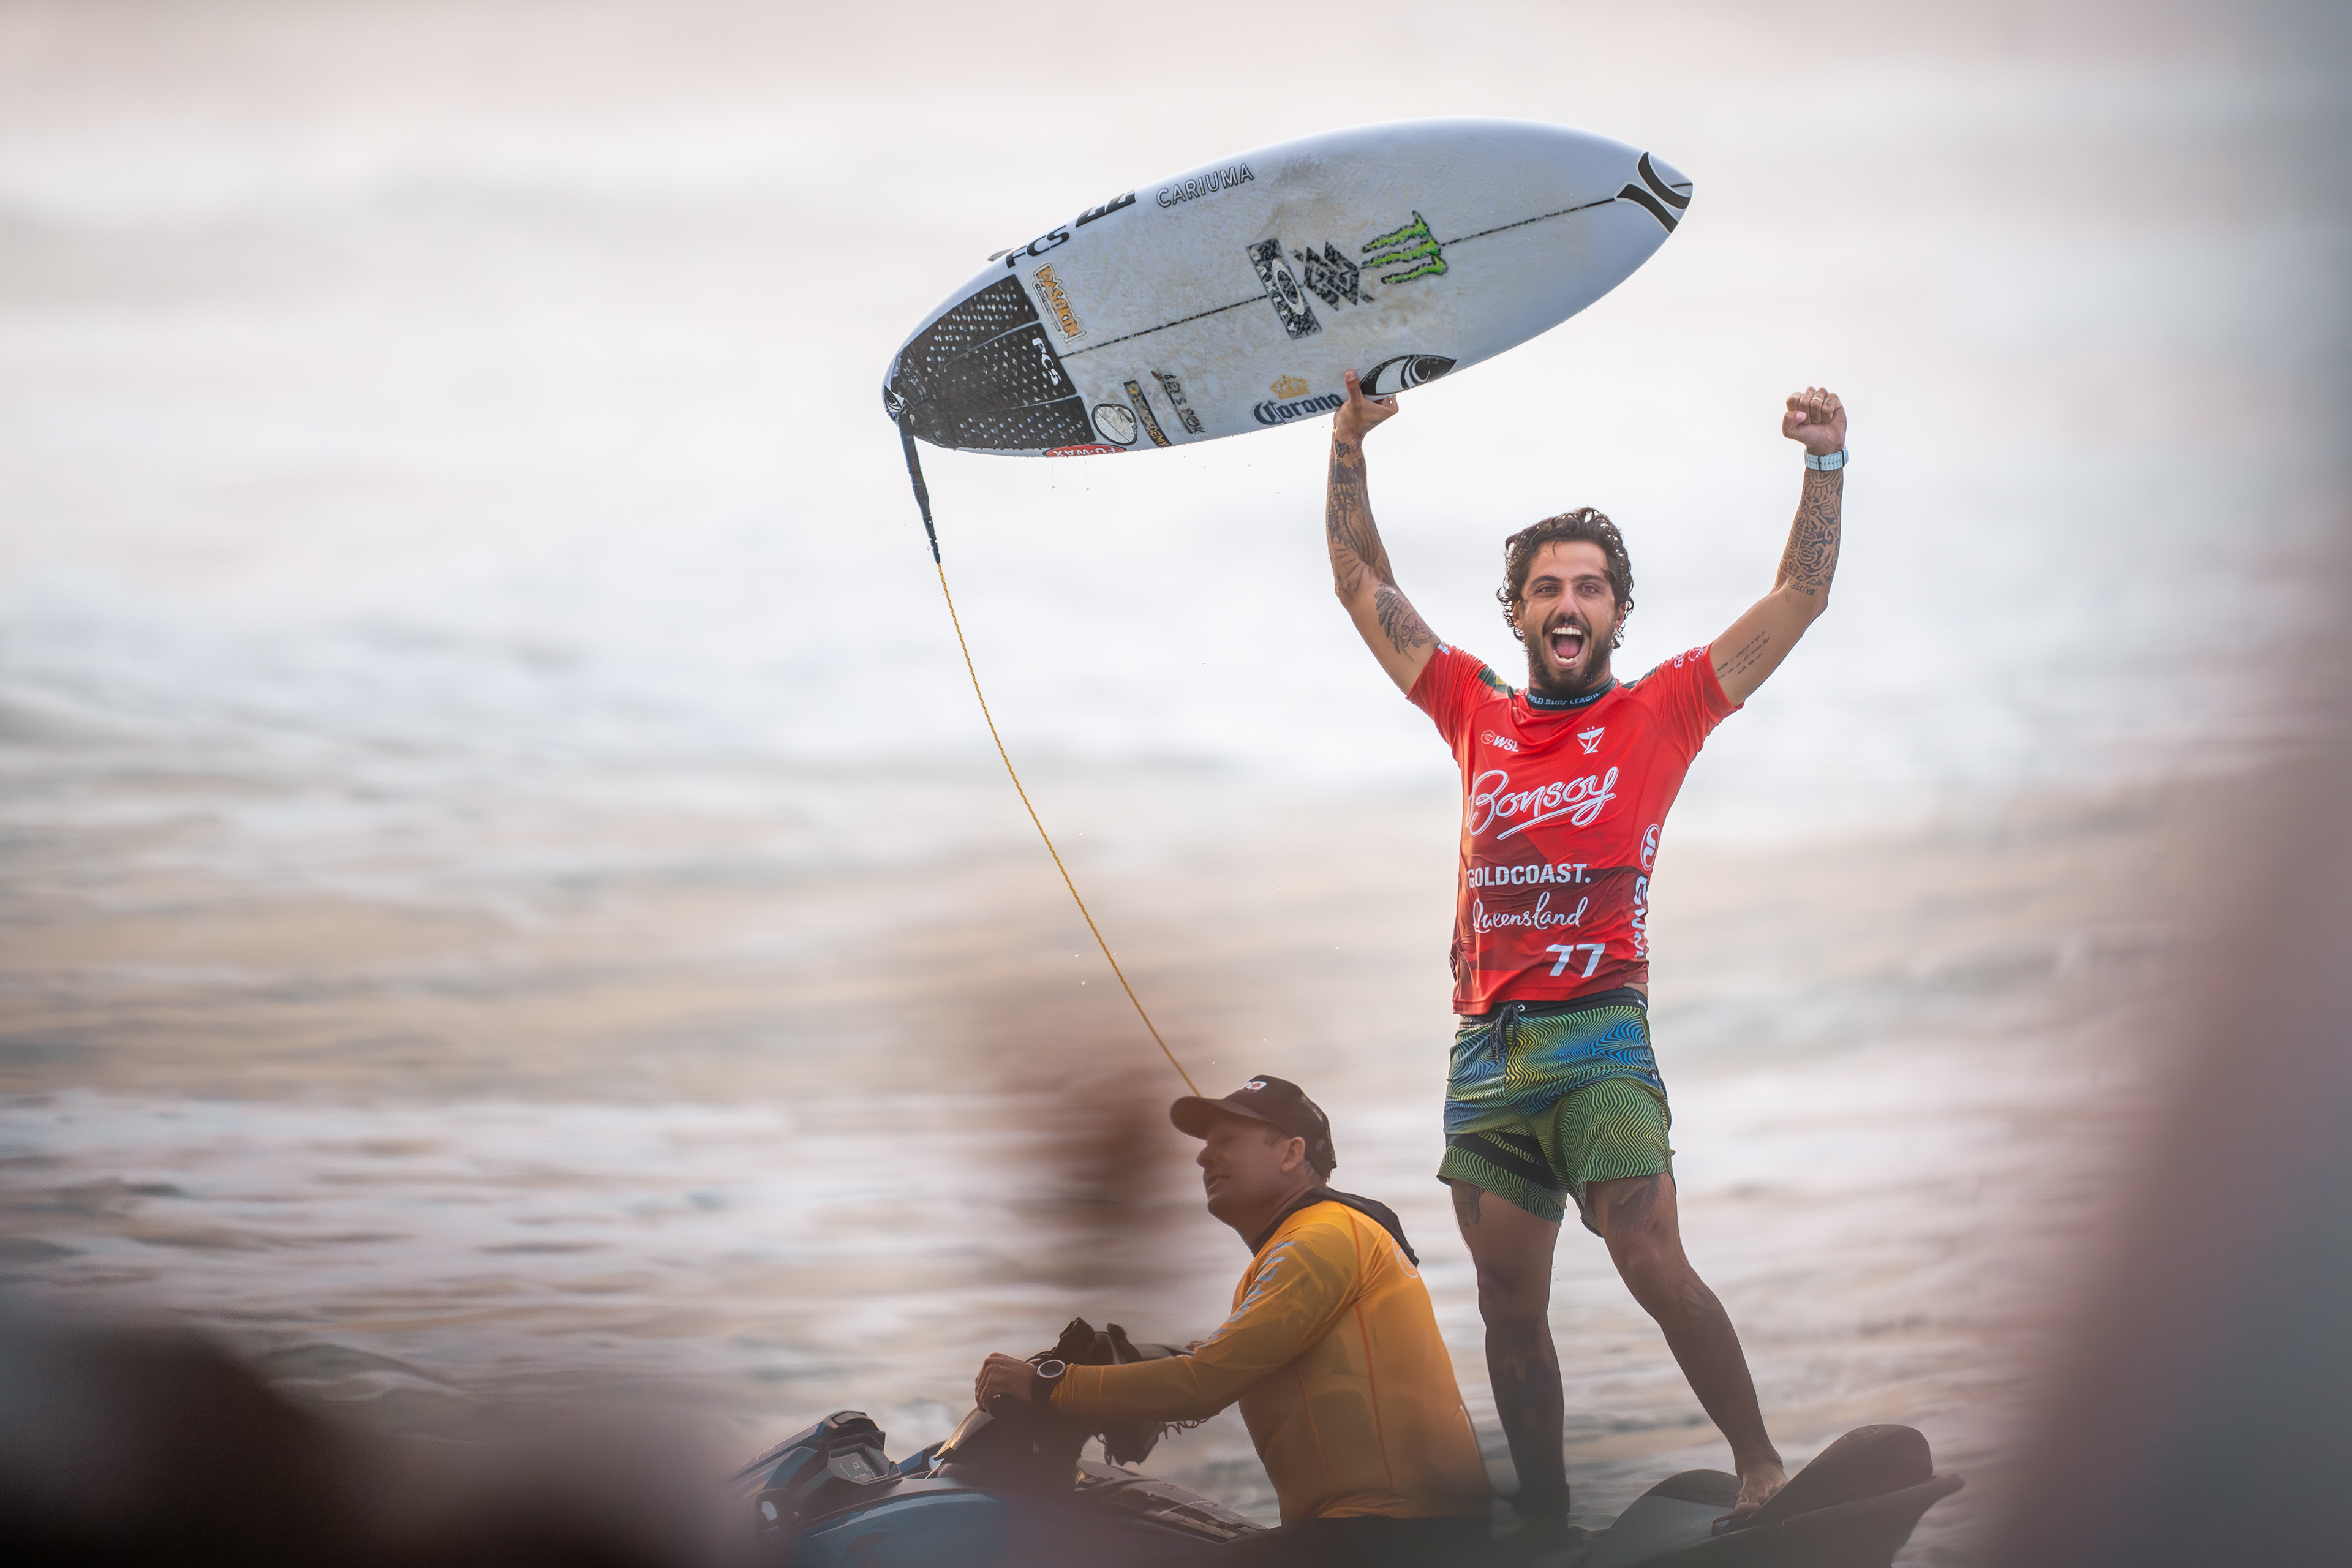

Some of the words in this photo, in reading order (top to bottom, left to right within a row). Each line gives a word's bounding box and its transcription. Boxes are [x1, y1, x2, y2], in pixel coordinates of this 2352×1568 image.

[1156, 162, 1254, 208] CARIUMA
[1006, 225, 1070, 268] FCS
[1250, 247, 1298, 333] OAKLEY
[1031, 337, 1063, 386] FCS
[1253, 393, 1344, 425] Corona
[1493, 735, 1519, 752] WSL
[1466, 766, 1619, 840] Bonsoy
[1466, 863, 1591, 888] GOLDCOAST.
[1472, 891, 1588, 934] Queensland
[1545, 942, 1605, 978] 77
